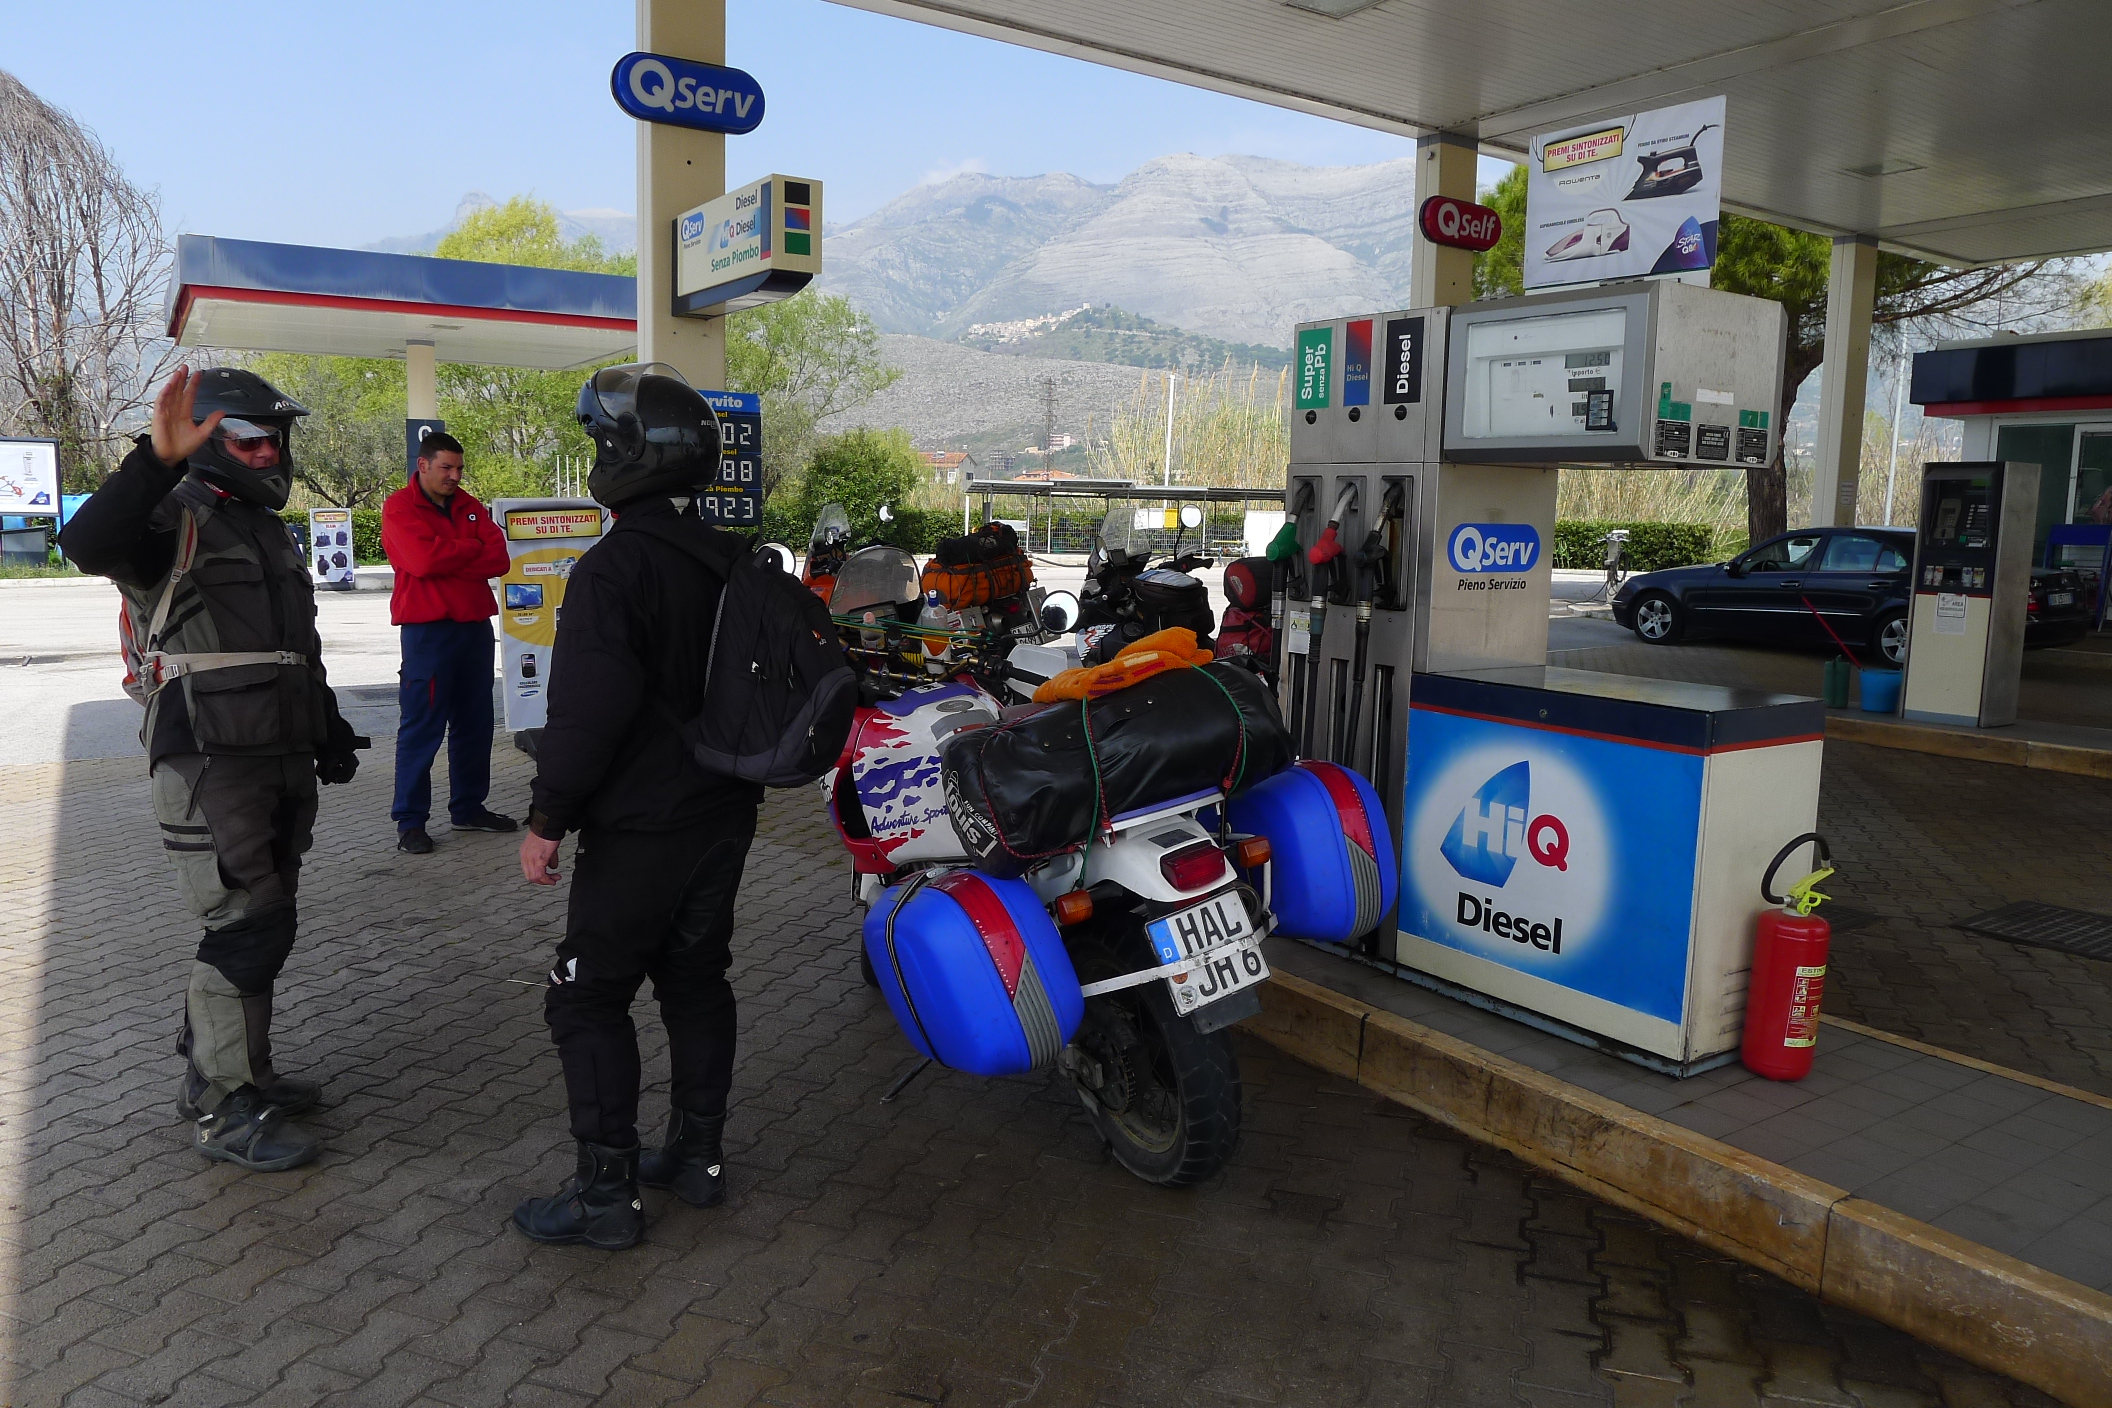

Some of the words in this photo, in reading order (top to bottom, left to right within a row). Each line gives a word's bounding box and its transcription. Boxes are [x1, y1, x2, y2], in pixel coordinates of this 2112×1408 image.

[1547, 146, 1570, 158] PREMI
[1571, 133, 1620, 153] SINTONIZZATI
[1566, 152, 1576, 163] SU
[1578, 151, 1586, 160] DI
[1587, 148, 1599, 159] TE.
[735, 189, 758, 211] Diesel
[736, 215, 756, 236] Diesel
[1677, 233, 1701, 249] STAR
[711, 256, 731, 273] Senza
[732, 244, 760, 265] Piombo
[1314, 343, 1327, 368] Pb
[1356, 363, 1362, 372] Q
[1396, 334, 1412, 394] Diesel
[1301, 345, 1316, 400] Super
[1318, 368, 1326, 399] senza
[1346, 373, 1368, 381] Diesel
[509, 517, 538, 526] PREMI
[540, 514, 597, 525] SINTONIZZATI
[535, 525, 547, 534] SU
[550, 525, 558, 533] DI
[561, 525, 574, 533] TE.
[1457, 578, 1486, 590] Pieno
[1488, 577, 1527, 590] Servizio
[871, 809, 919, 833] Adventure
[963, 800, 975, 813] FUN
[974, 812, 999, 836] COMPANY
[1175, 901, 1243, 954] HAL
[1456, 891, 1563, 955] Diesel
[1163, 947, 1173, 959] D
[1198, 956, 1239, 997] JH
[1242, 949, 1262, 976] 6
